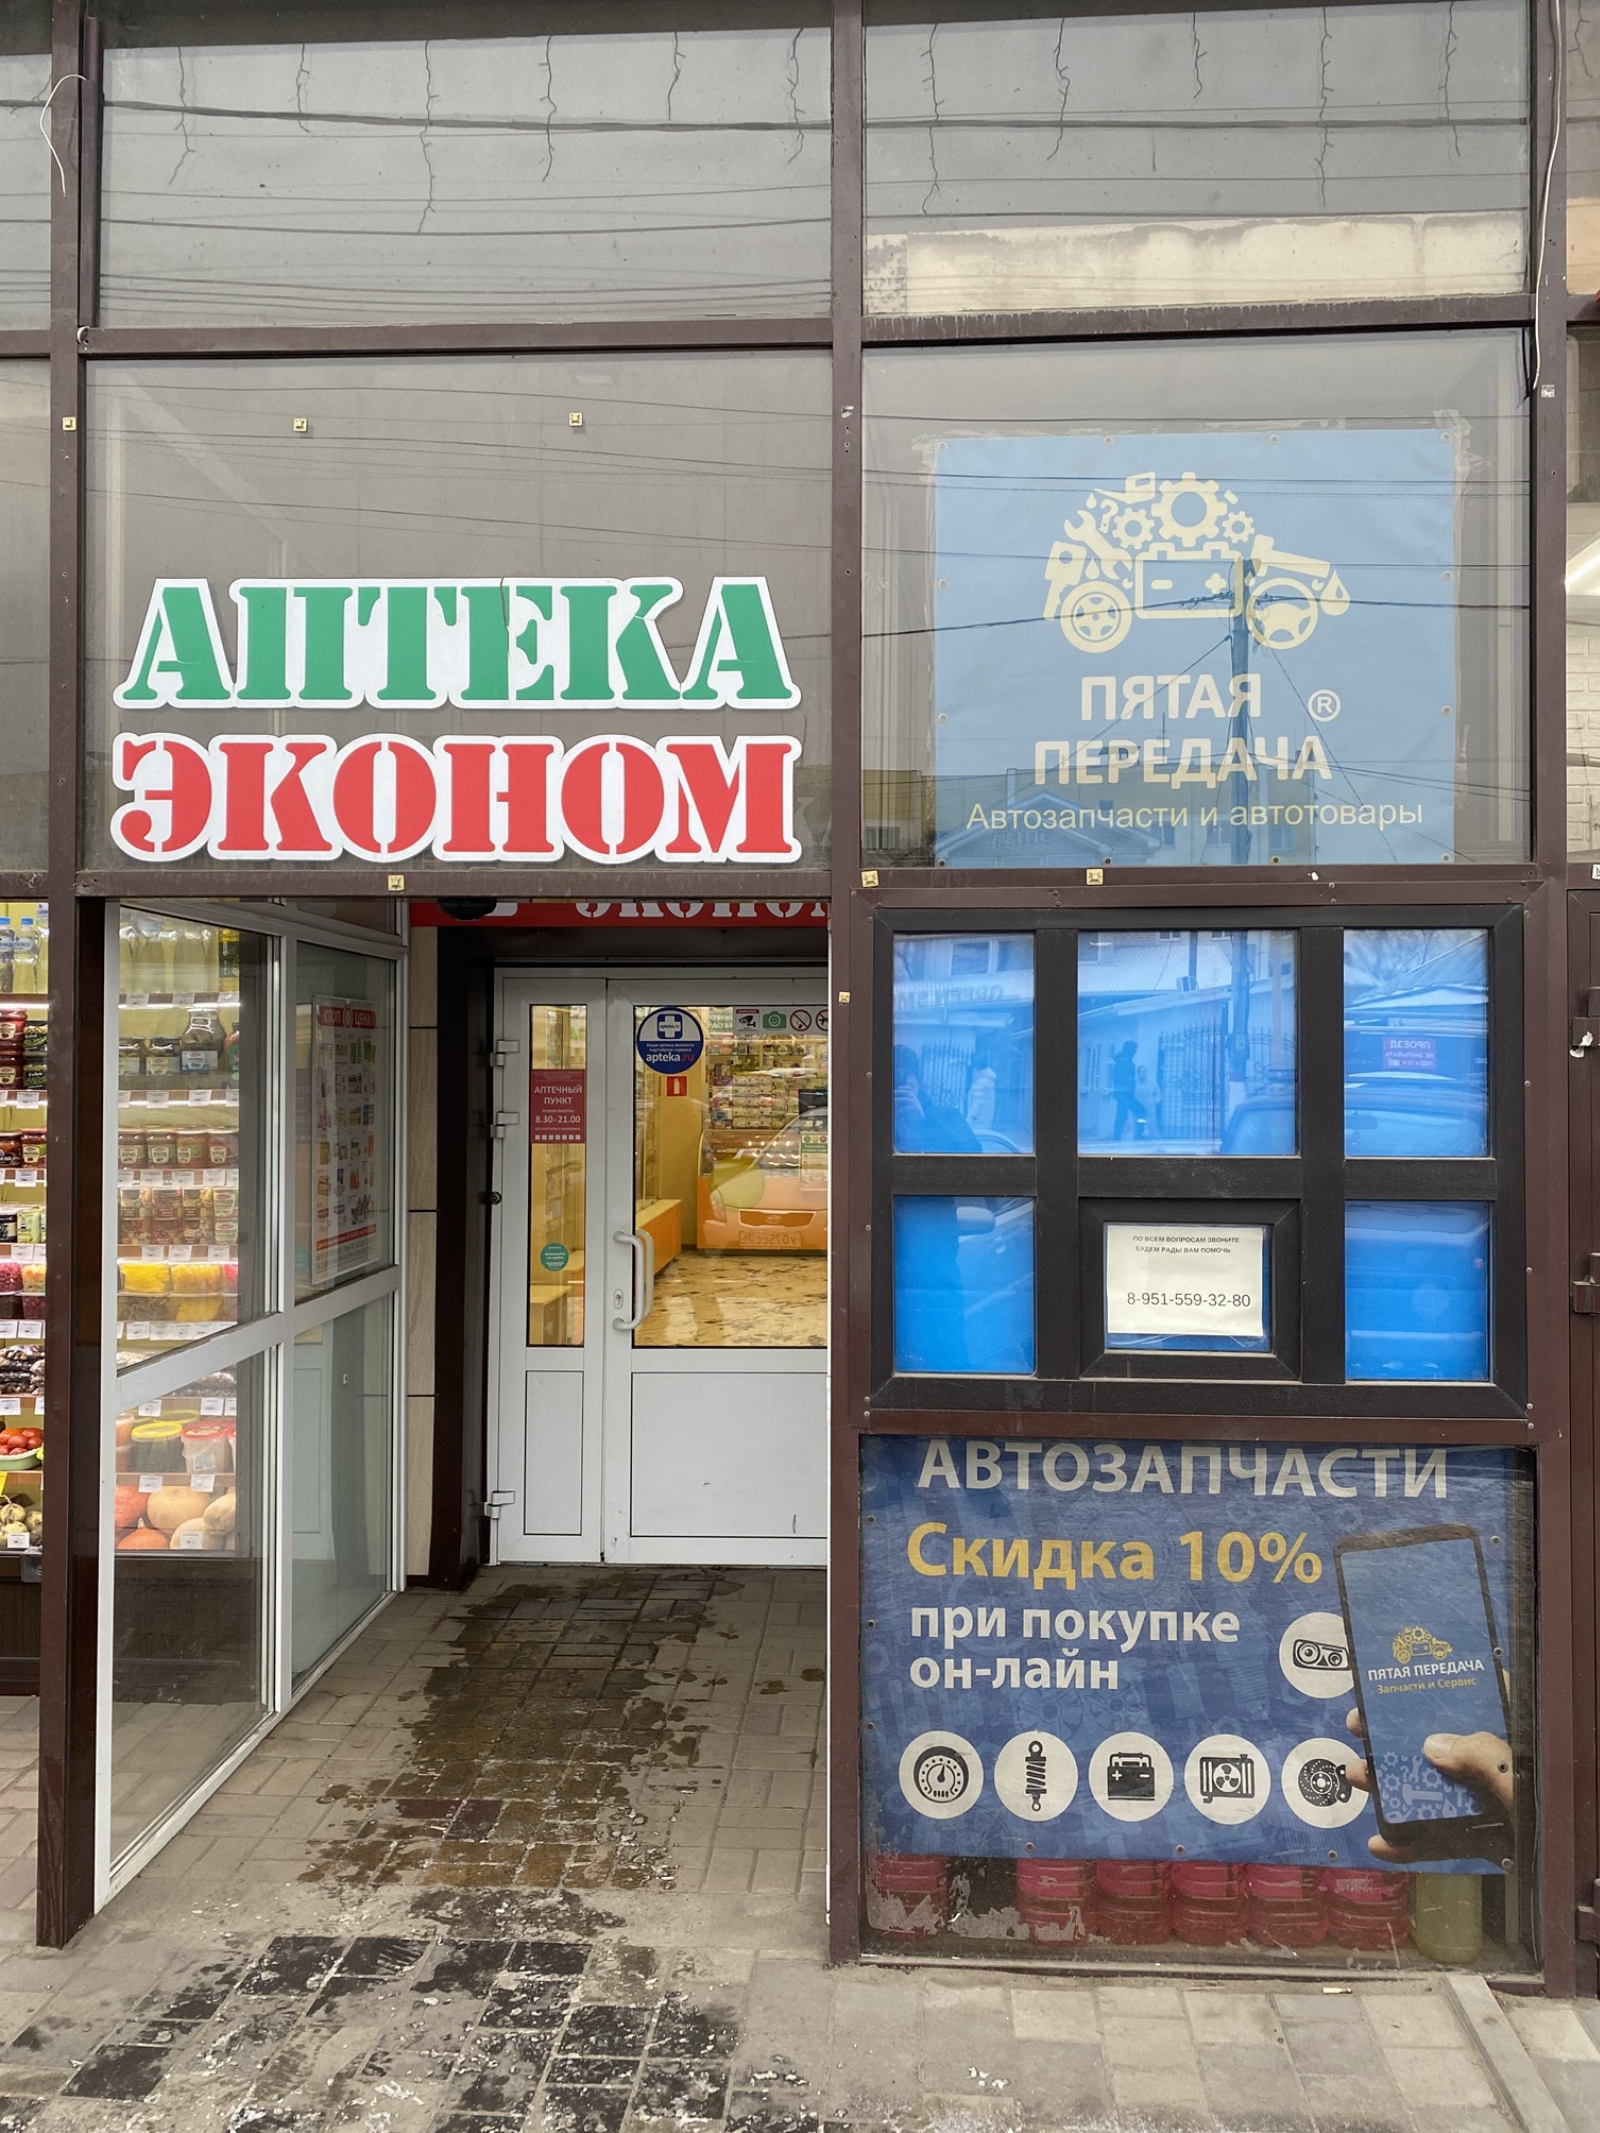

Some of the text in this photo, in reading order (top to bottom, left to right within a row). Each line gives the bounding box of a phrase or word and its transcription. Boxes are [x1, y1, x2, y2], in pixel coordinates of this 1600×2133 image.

[116, 580, 798, 705] АПТЕКА
[1080, 673, 1262, 721] ПЯТАЯ
[1034, 735, 1333, 789] ПЕРЕДАЧА
[115, 736, 798, 860] ЭКОНОМ
[966, 802, 1424, 832] Автозапчасти и автотовары
[646, 1052, 694, 1064] apteka.ru
[534, 1084, 582, 1094] АПТЕЧНЫЙ
[544, 1096, 573, 1104] ПУНКТ
[1135, 1245, 1160, 1253] БУДЕМ
[1161, 1246, 1182, 1254] РАДЫ
[1127, 1291, 1251, 1308] 8-951-559-32-80
[916, 1439, 1447, 1499] АВТОЗАПЧАСТИ
[906, 1521, 1323, 1590] Скидка 10%
[910, 1605, 1241, 1652] при покупке
[909, 1647, 1119, 1691] он-лайн
[1367, 1659, 1485, 1681] ПЯТАЯ ПЕРЕДАЧА
[1377, 1677, 1478, 1694] Запчасти и Сервис
